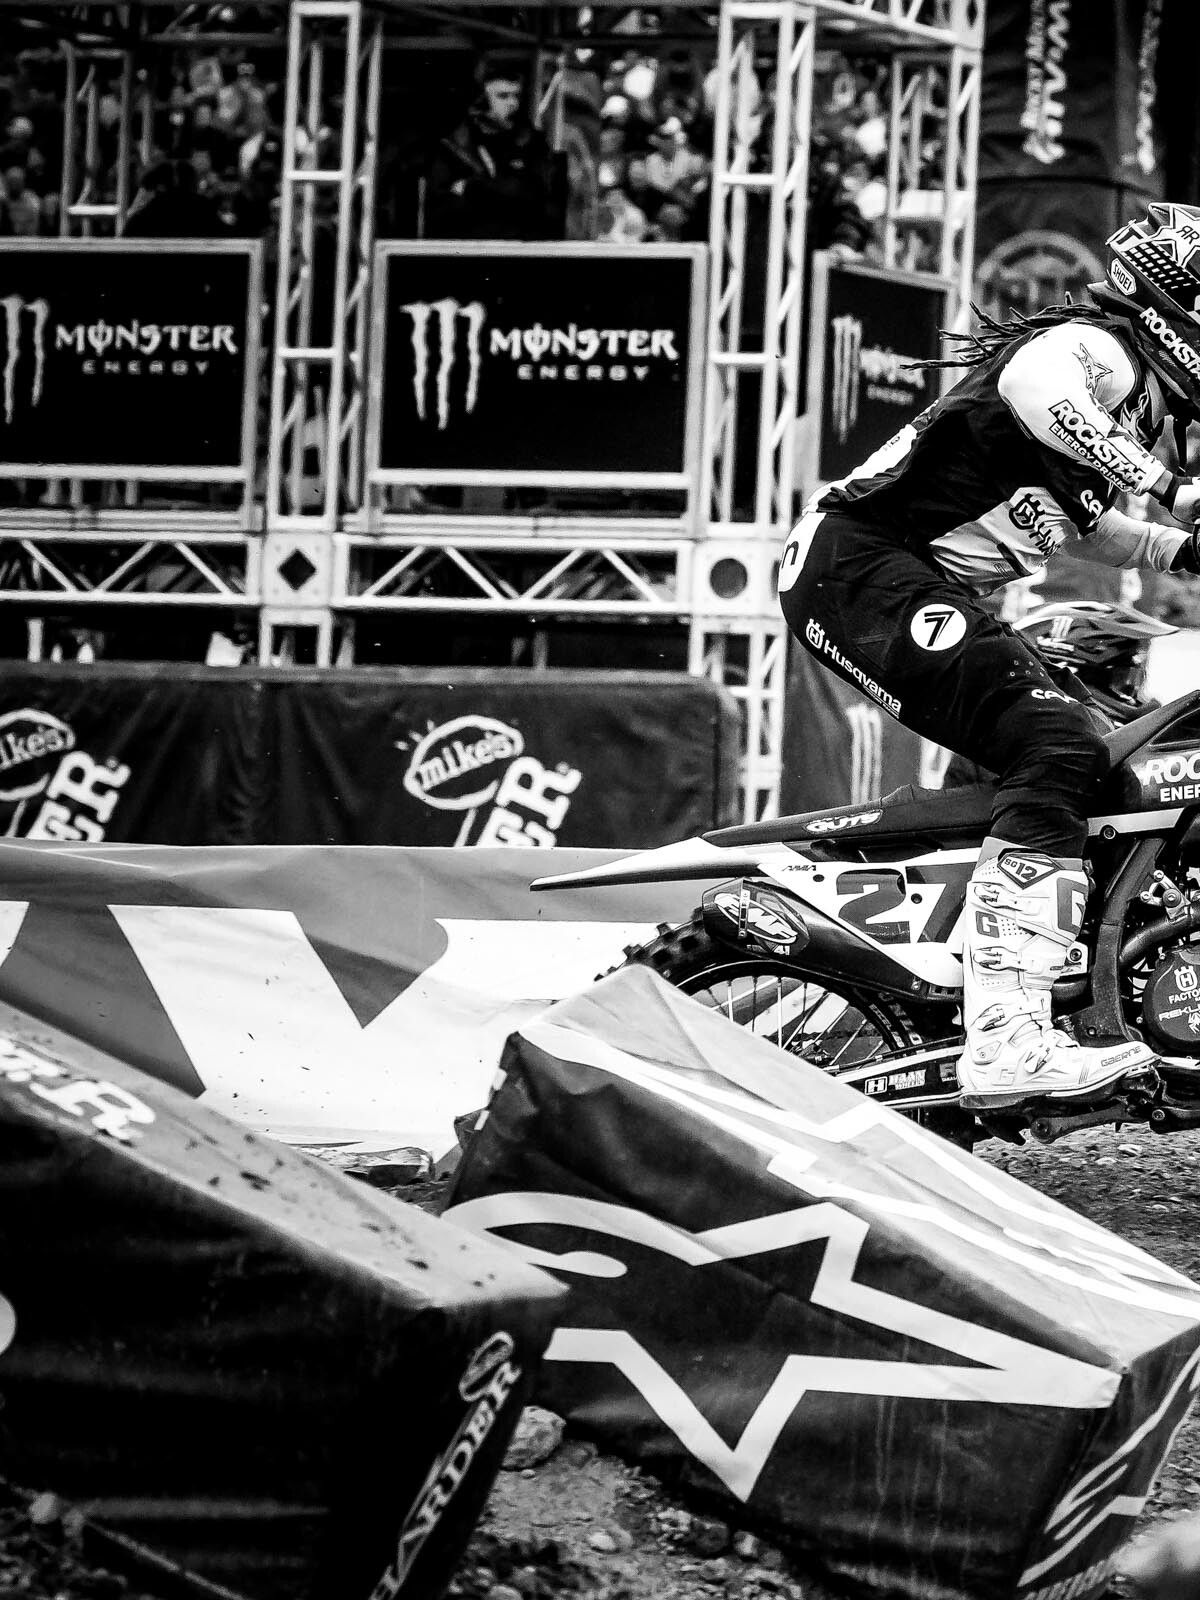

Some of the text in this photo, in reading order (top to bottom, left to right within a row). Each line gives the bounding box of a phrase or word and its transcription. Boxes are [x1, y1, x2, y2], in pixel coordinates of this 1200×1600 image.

[1112, 262, 1134, 292] SHOEI
[55, 318, 238, 356] MONSTER
[489, 322, 679, 361] MONSTER
[82, 359, 209, 375] ENERGY
[517, 364, 649, 381] ENERGY
[1050, 422, 1127, 490] ENERGY DRINK
[924, 610, 956, 648] 7
[824, 639, 902, 713] Husqvarna
[418, 731, 514, 791] mike's
[805, 810, 882, 833] GUTS
[836, 861, 978, 945] 27
